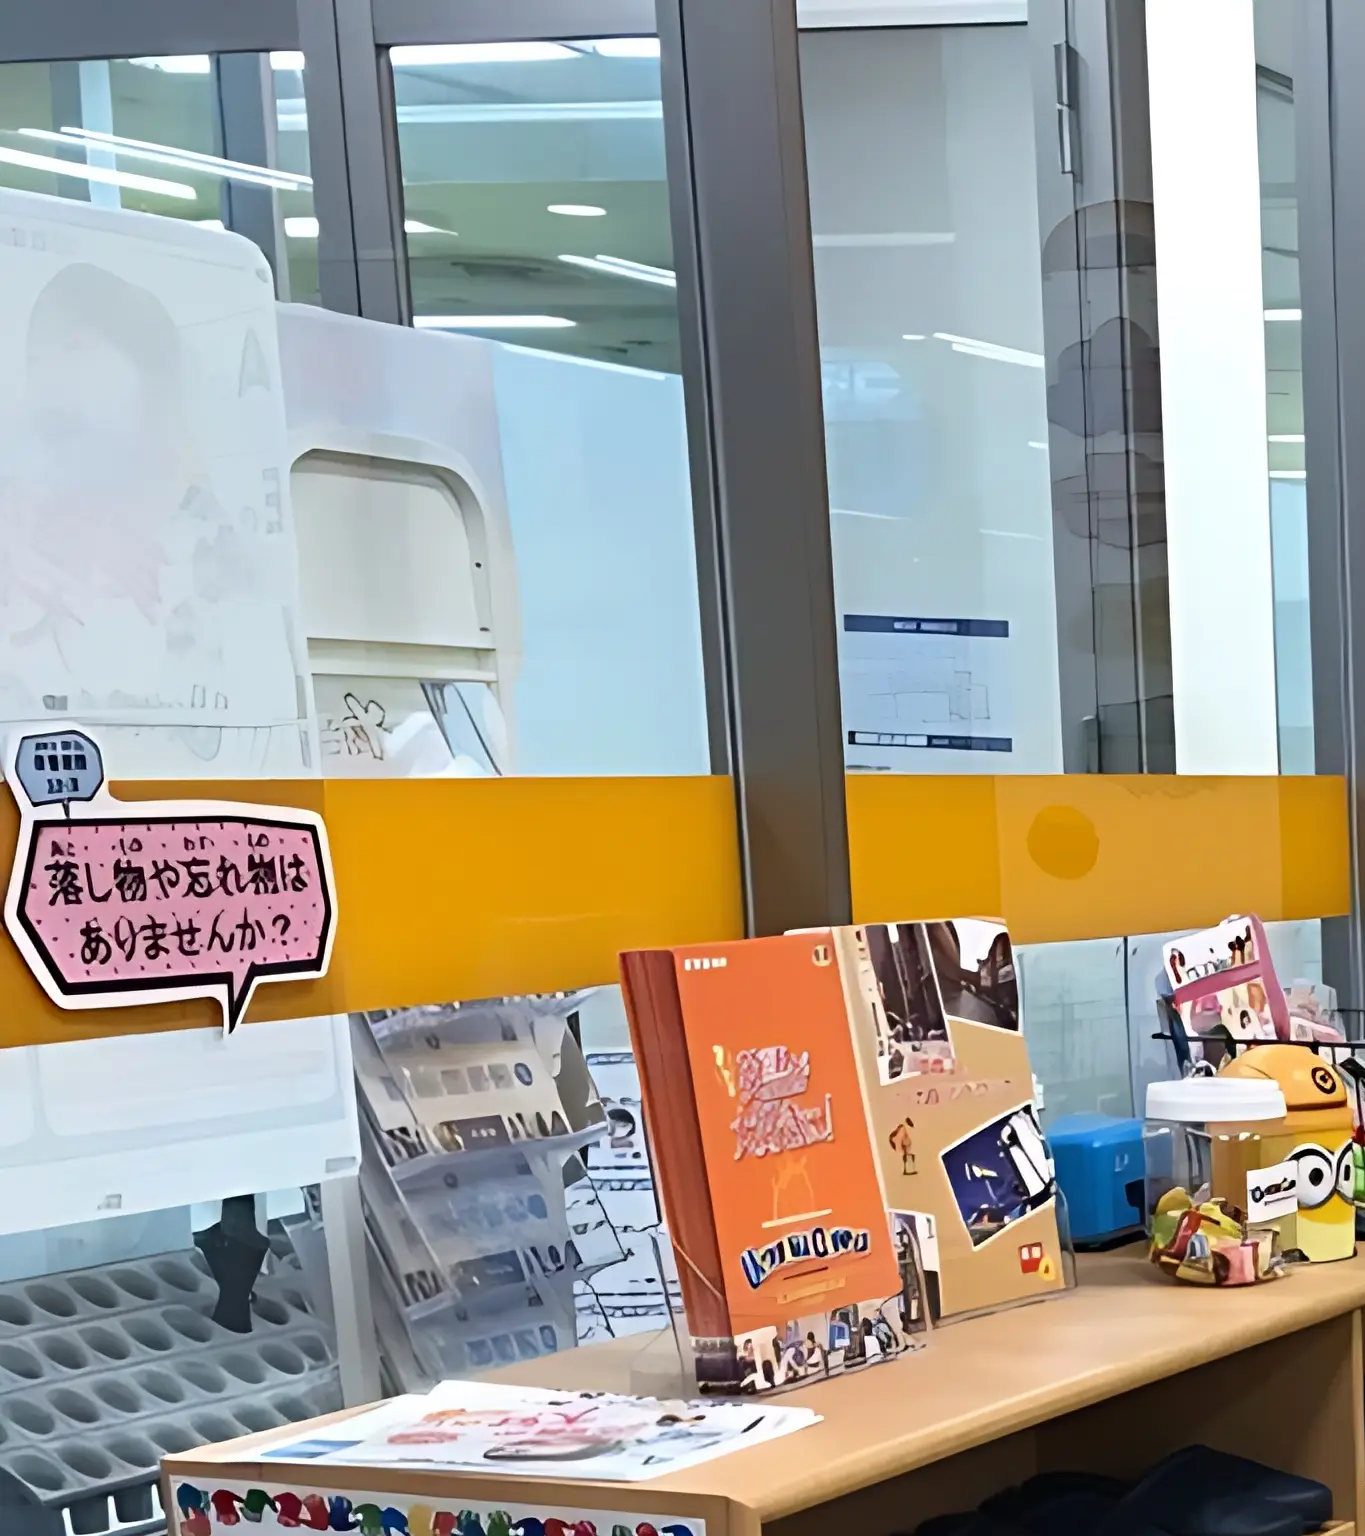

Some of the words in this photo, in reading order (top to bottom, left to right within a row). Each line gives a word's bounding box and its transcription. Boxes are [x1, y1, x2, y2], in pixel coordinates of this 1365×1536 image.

[80, 907, 292, 966] ありませんか？
